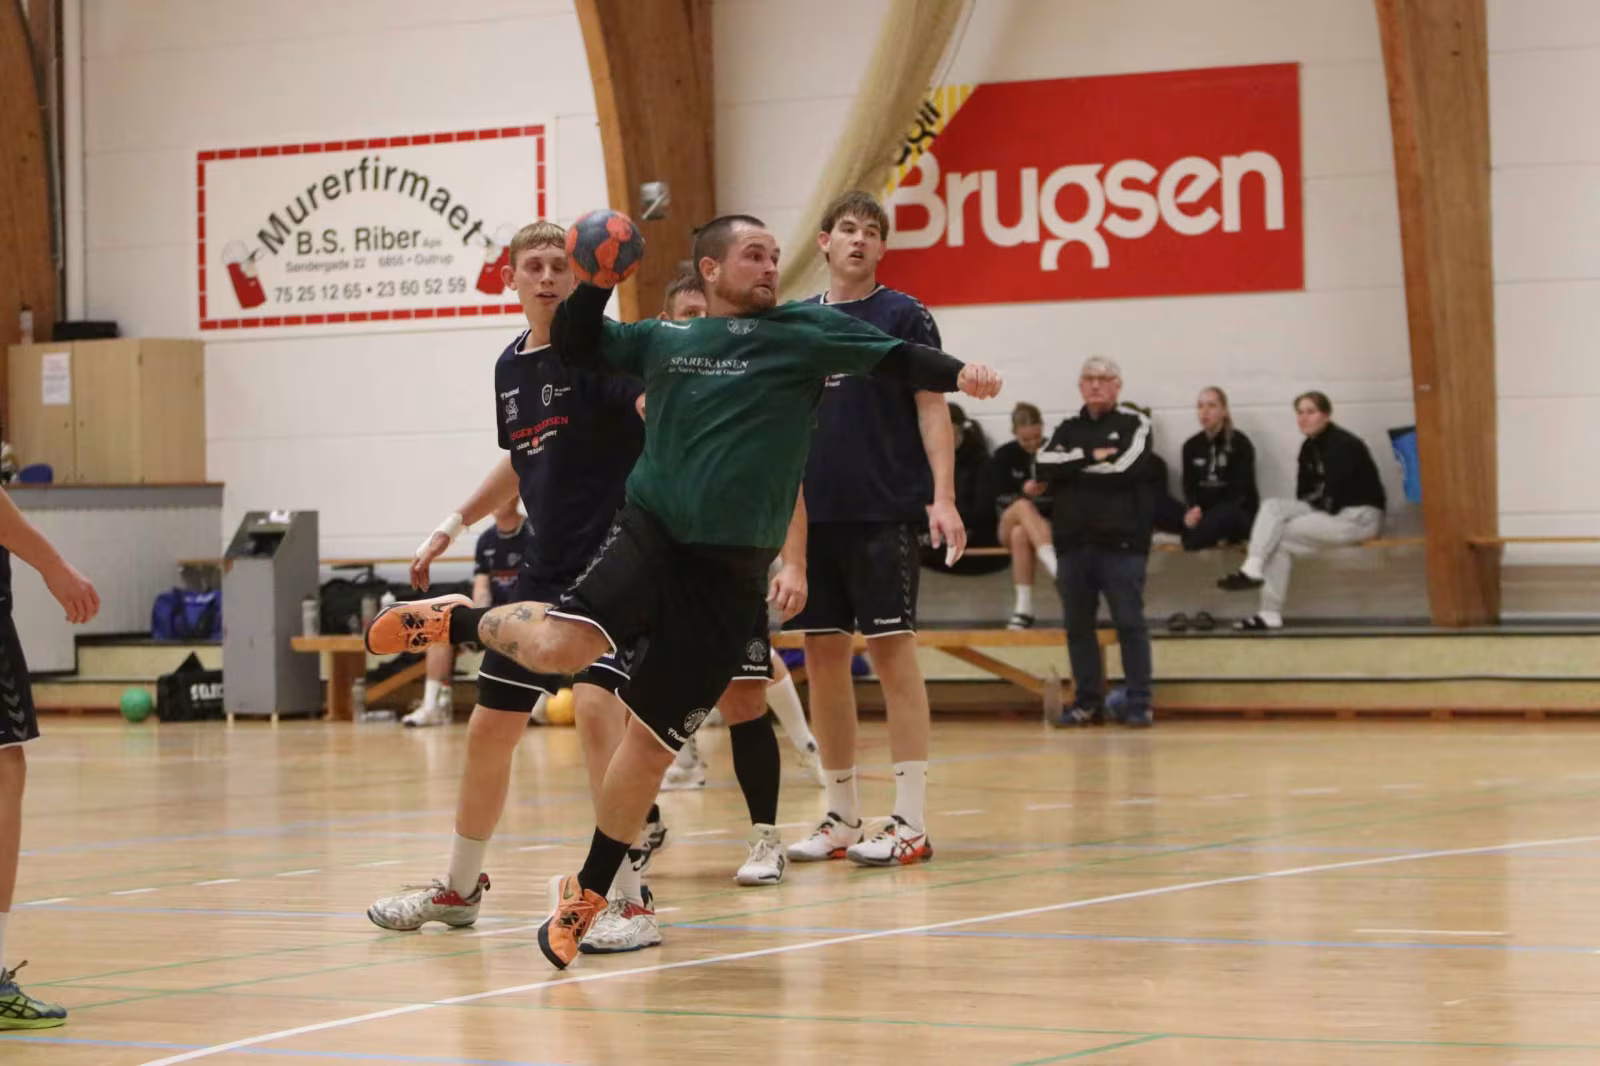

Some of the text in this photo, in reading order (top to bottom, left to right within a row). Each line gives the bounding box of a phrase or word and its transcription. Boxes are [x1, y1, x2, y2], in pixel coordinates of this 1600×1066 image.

[256, 155, 484, 255] Murerfirmaet
[886, 150, 1285, 271] Brugsen
[296, 229, 346, 256] B.S.
[354, 225, 421, 252] Riber
[353, 258, 366, 269] 22
[275, 276, 468, 303] 75 25 12 65 23 60 52 59
[670, 356, 750, 369] SPAREKASSEN
